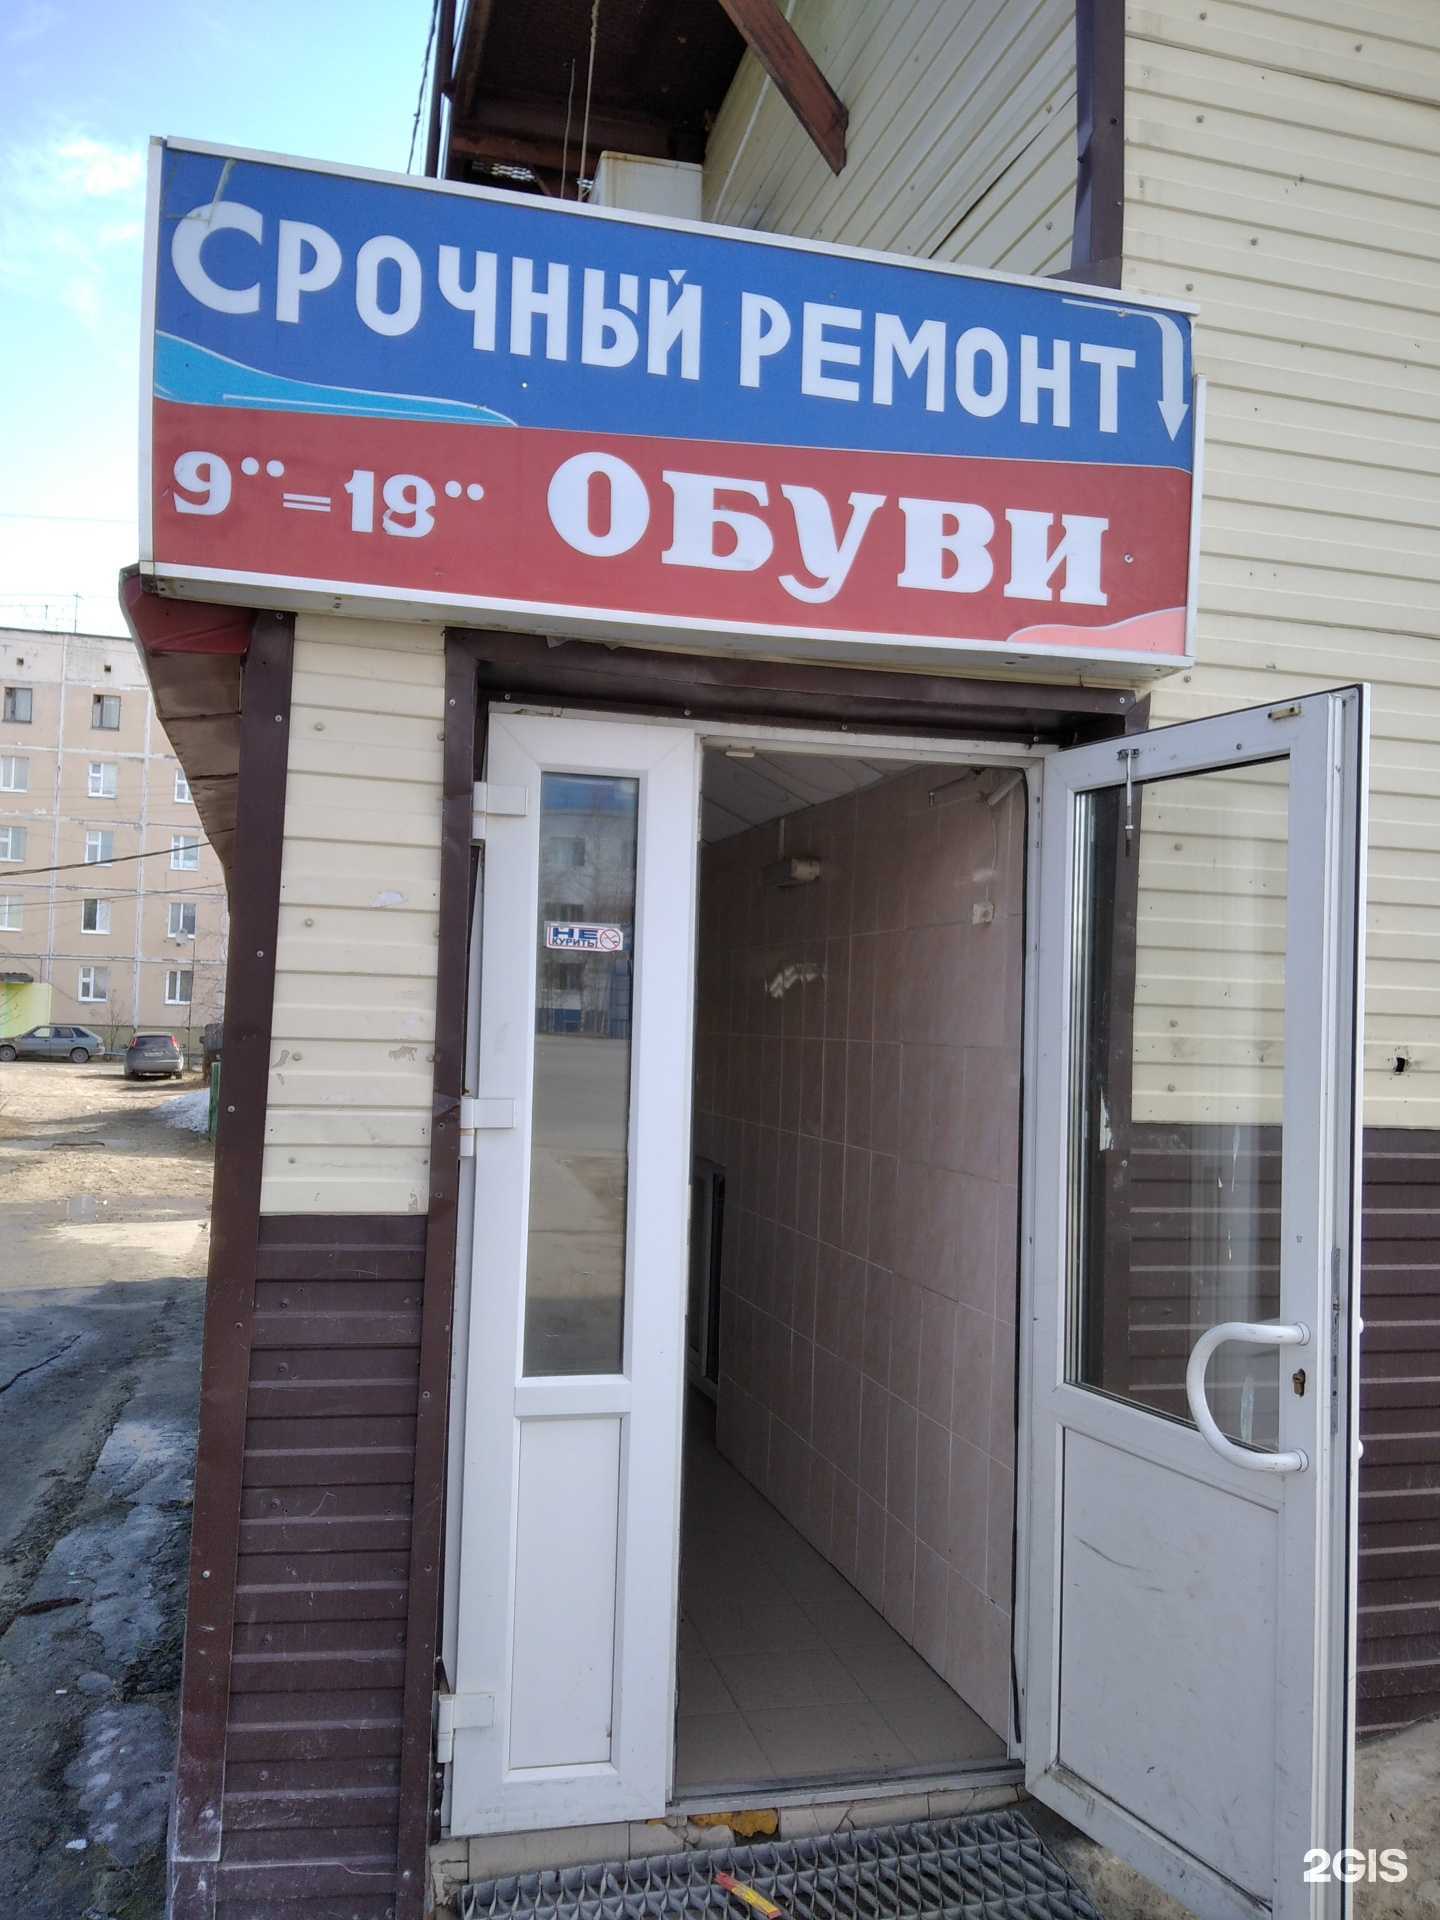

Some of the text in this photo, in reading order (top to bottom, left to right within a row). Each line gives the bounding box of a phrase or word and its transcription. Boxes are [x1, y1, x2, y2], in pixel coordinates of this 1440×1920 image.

[170, 200, 1138, 434] СРОЧНЫЙ РЕМОНТ
[546, 451, 1109, 607] ОБУВИ
[552, 927, 598, 940] НЕ
